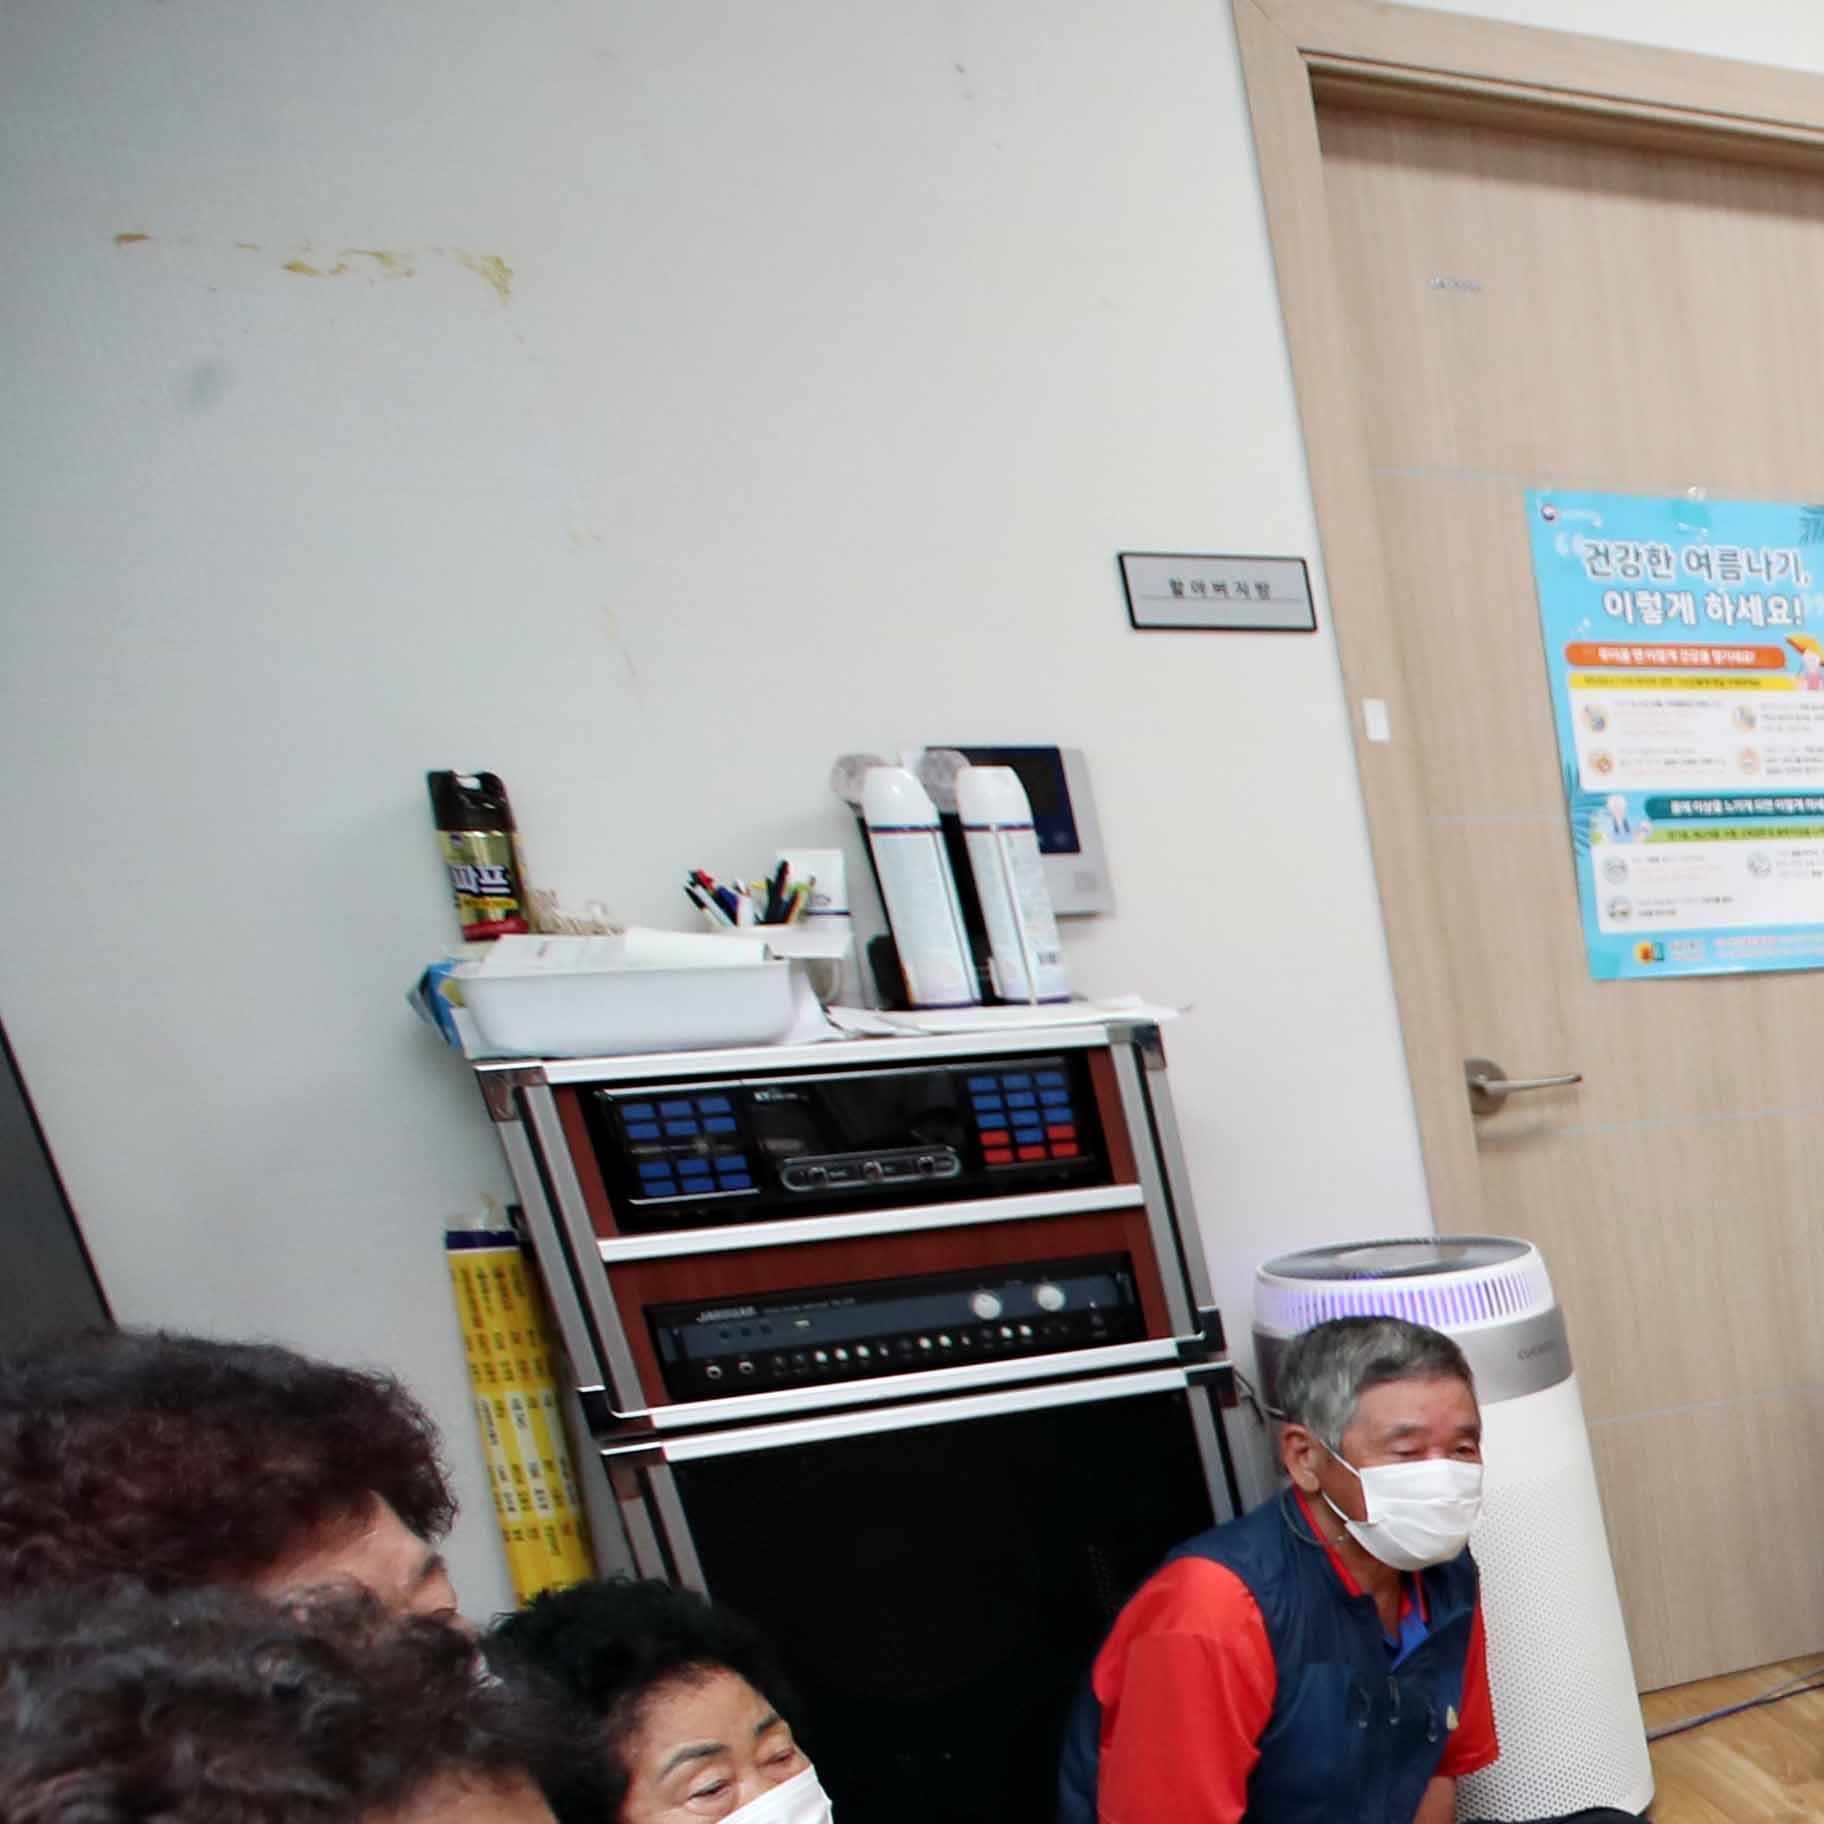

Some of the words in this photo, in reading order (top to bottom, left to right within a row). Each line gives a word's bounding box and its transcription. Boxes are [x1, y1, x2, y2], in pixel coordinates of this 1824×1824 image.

[1582, 538, 1674, 579] 건강한
[1602, 589, 1697, 626] 이렇게
[1704, 592, 1806, 628] 하세요!
